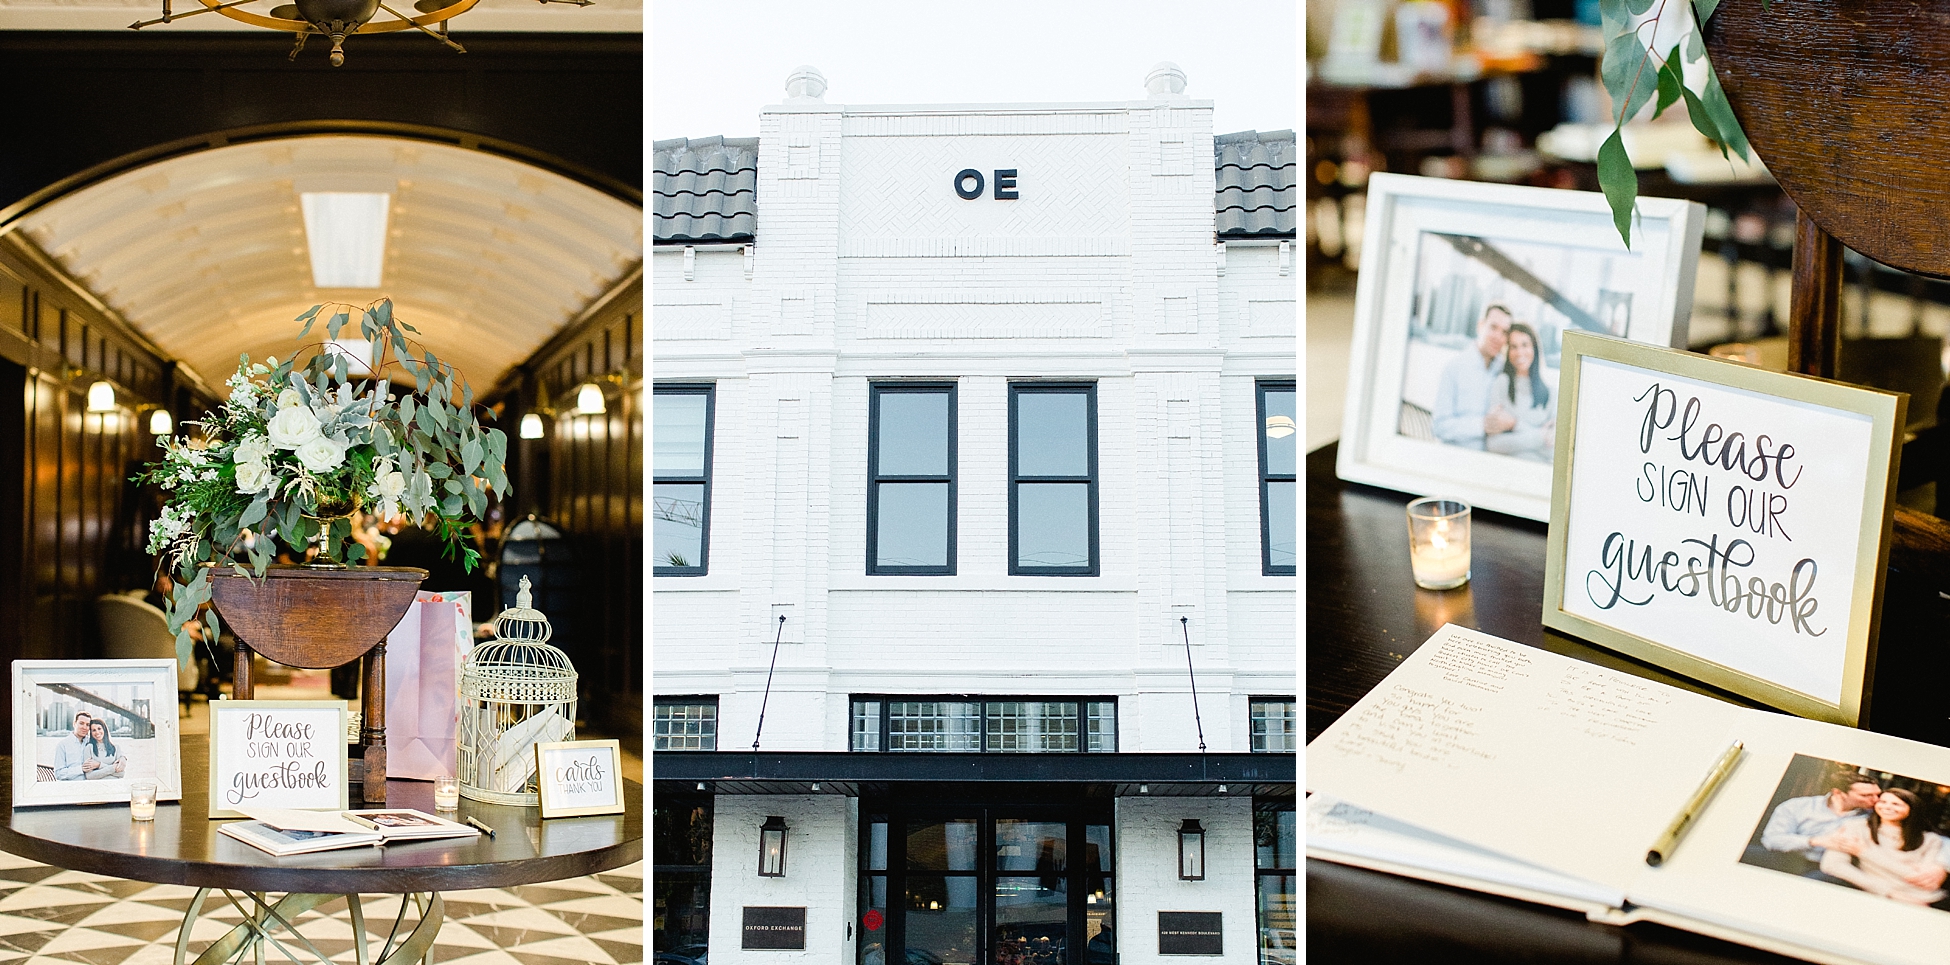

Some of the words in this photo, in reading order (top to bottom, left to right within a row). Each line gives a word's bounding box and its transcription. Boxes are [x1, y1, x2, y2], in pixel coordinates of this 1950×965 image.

[954, 168, 1019, 200] OE
[1633, 383, 1803, 489] Please
[1637, 462, 1708, 517] SIGN
[1727, 485, 1792, 541] OUR
[1586, 531, 1827, 637] guestbook
[242, 713, 315, 740] Please
[246, 741, 279, 758] SIGN
[286, 741, 314, 758] OUR
[226, 761, 331, 805] guestbook
[555, 755, 606, 783] cards
[558, 782, 586, 794] THANK
[587, 781, 603, 793] YOU
